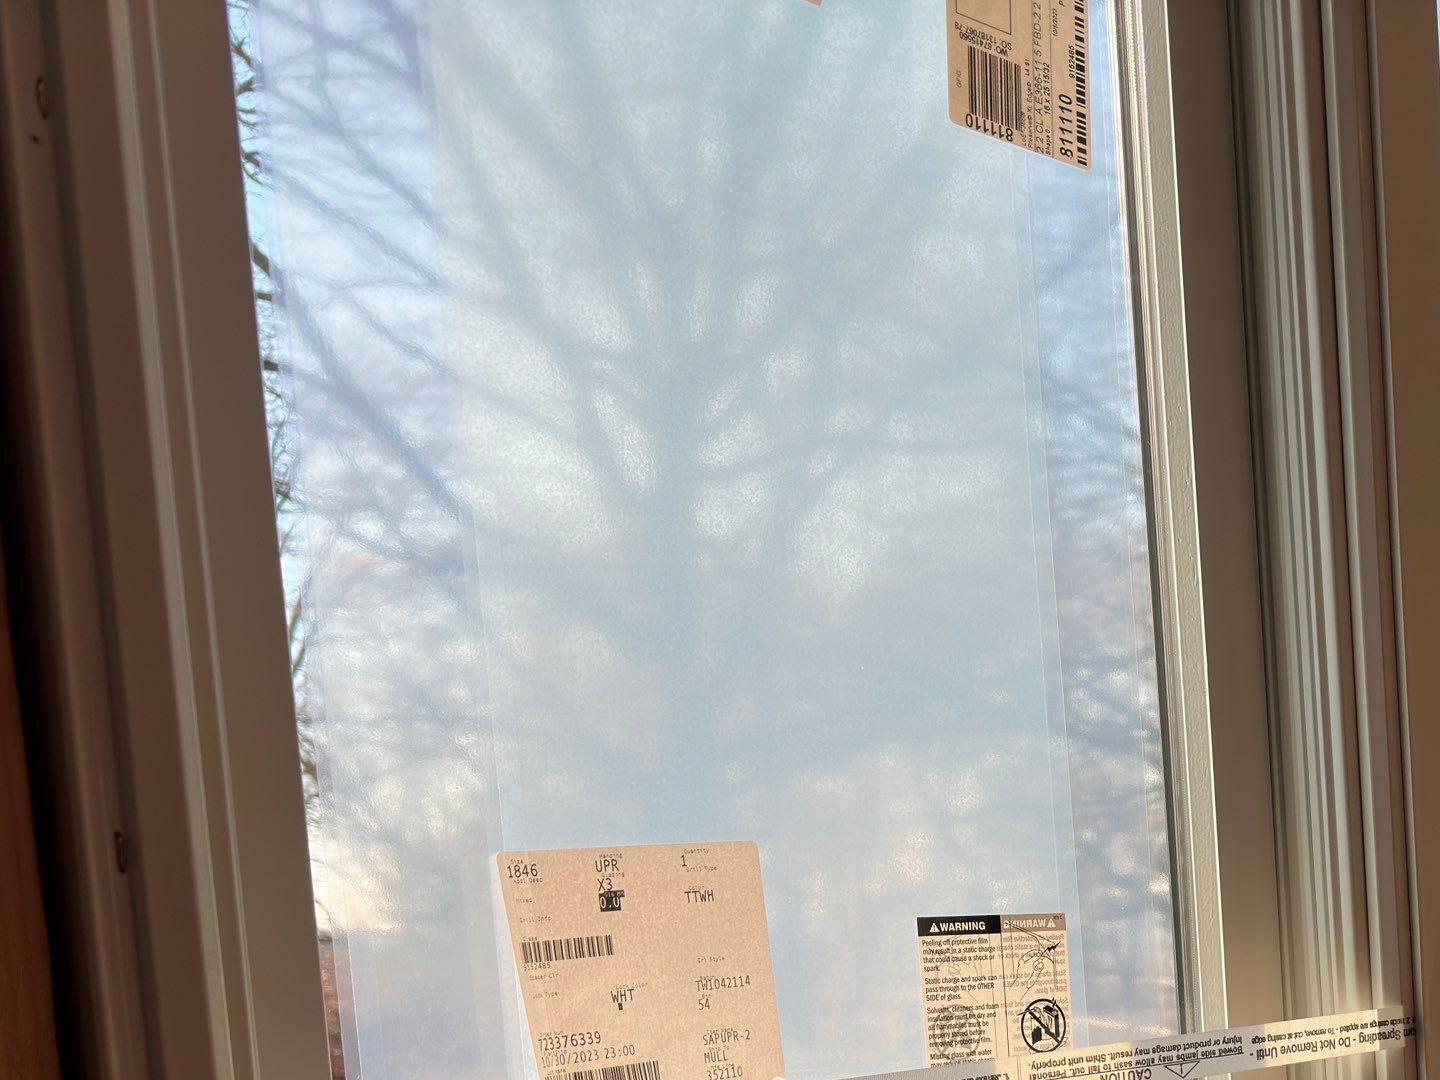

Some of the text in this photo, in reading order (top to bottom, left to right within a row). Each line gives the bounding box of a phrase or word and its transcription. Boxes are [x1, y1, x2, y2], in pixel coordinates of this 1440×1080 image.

[965, 113, 1013, 142] 811110
[1059, 94, 1073, 159] 811110
[595, 859, 620, 873] UPR
[680, 854, 688, 867] 1
[507, 864, 538, 878] 1846
[597, 878, 613, 892] X3
[684, 890, 715, 904] TTWH
[940, 921, 986, 932] WARNING
[922, 938, 977, 947] Peeling protective
[940, 985, 960, 993] through
[977, 982, 995, 990] OTHER
[610, 988, 634, 1004] WHT
[698, 998, 710, 1011] 54
[538, 1031, 601, 1052] 723376339
[703, 1029, 751, 1046] SAPUPR-2
[1223, 1036, 1242, 1046] Injury
[1152, 1043, 1182, 1055] damage
[1183, 1040, 1212, 1051] product
[1256, 1029, 1402, 1061] Spreading Do Not Remove Until
[541, 1044, 636, 1069] 10/30/2023 23:00
[704, 1050, 729, 1064] MULL
[1130, 1047, 1150, 1058] may
[1176, 1051, 1198, 1063] jambs
[1201, 1049, 1216, 1059] side
[1219, 1046, 1244, 1057] Bowed
[1028, 1058, 1066, 1071] properly.
[1068, 1056, 1084, 1066] unit
[1086, 1053, 1107, 1064] Shim
[1135, 1058, 1156, 1068] allow
[1158, 1054, 1174, 1065] may
[1088, 1064, 1101, 1074] fall
[1103, 1063, 1112, 1071] to
[1114, 1060, 1133, 1070] sash
